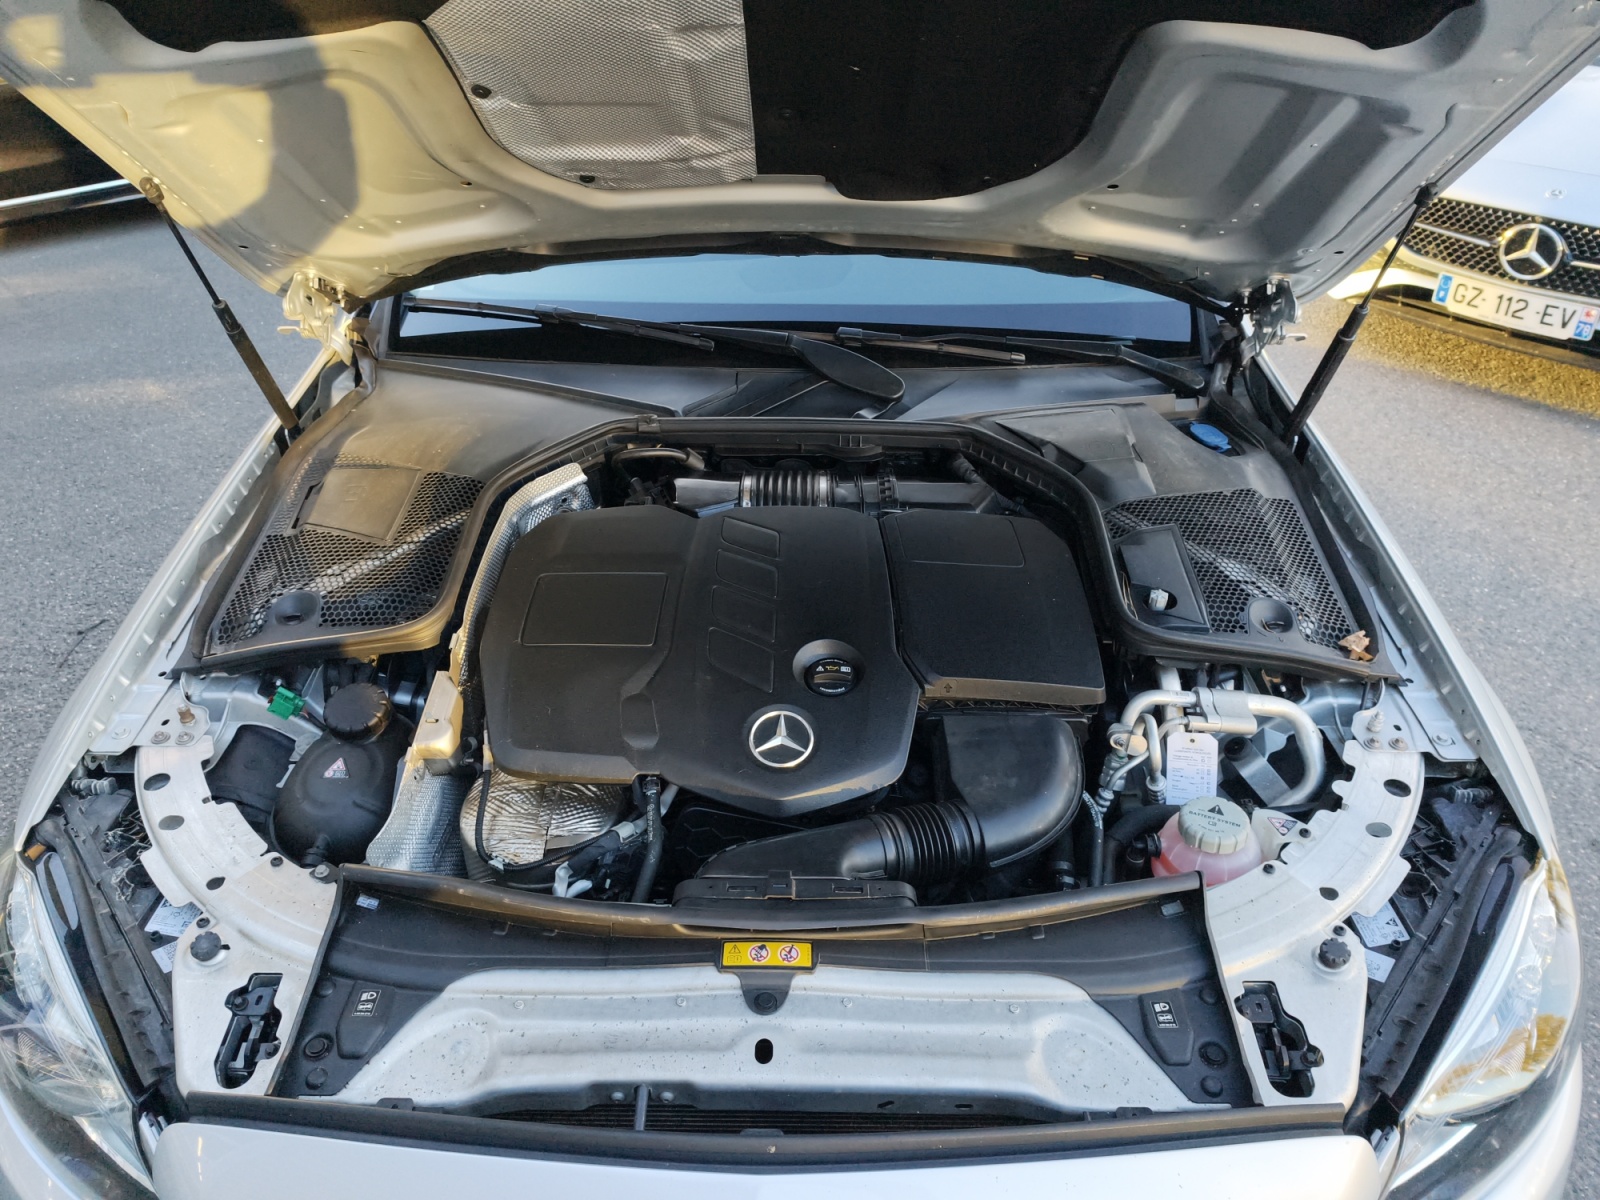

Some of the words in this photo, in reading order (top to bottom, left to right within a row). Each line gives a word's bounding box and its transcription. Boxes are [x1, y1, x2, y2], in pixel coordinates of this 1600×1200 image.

[1495, 294, 1529, 320] 112
[1575, 323, 1591, 336] 78
[1188, 810, 1216, 820] BATTERY
[1217, 818, 1241, 828] SYSTEM
